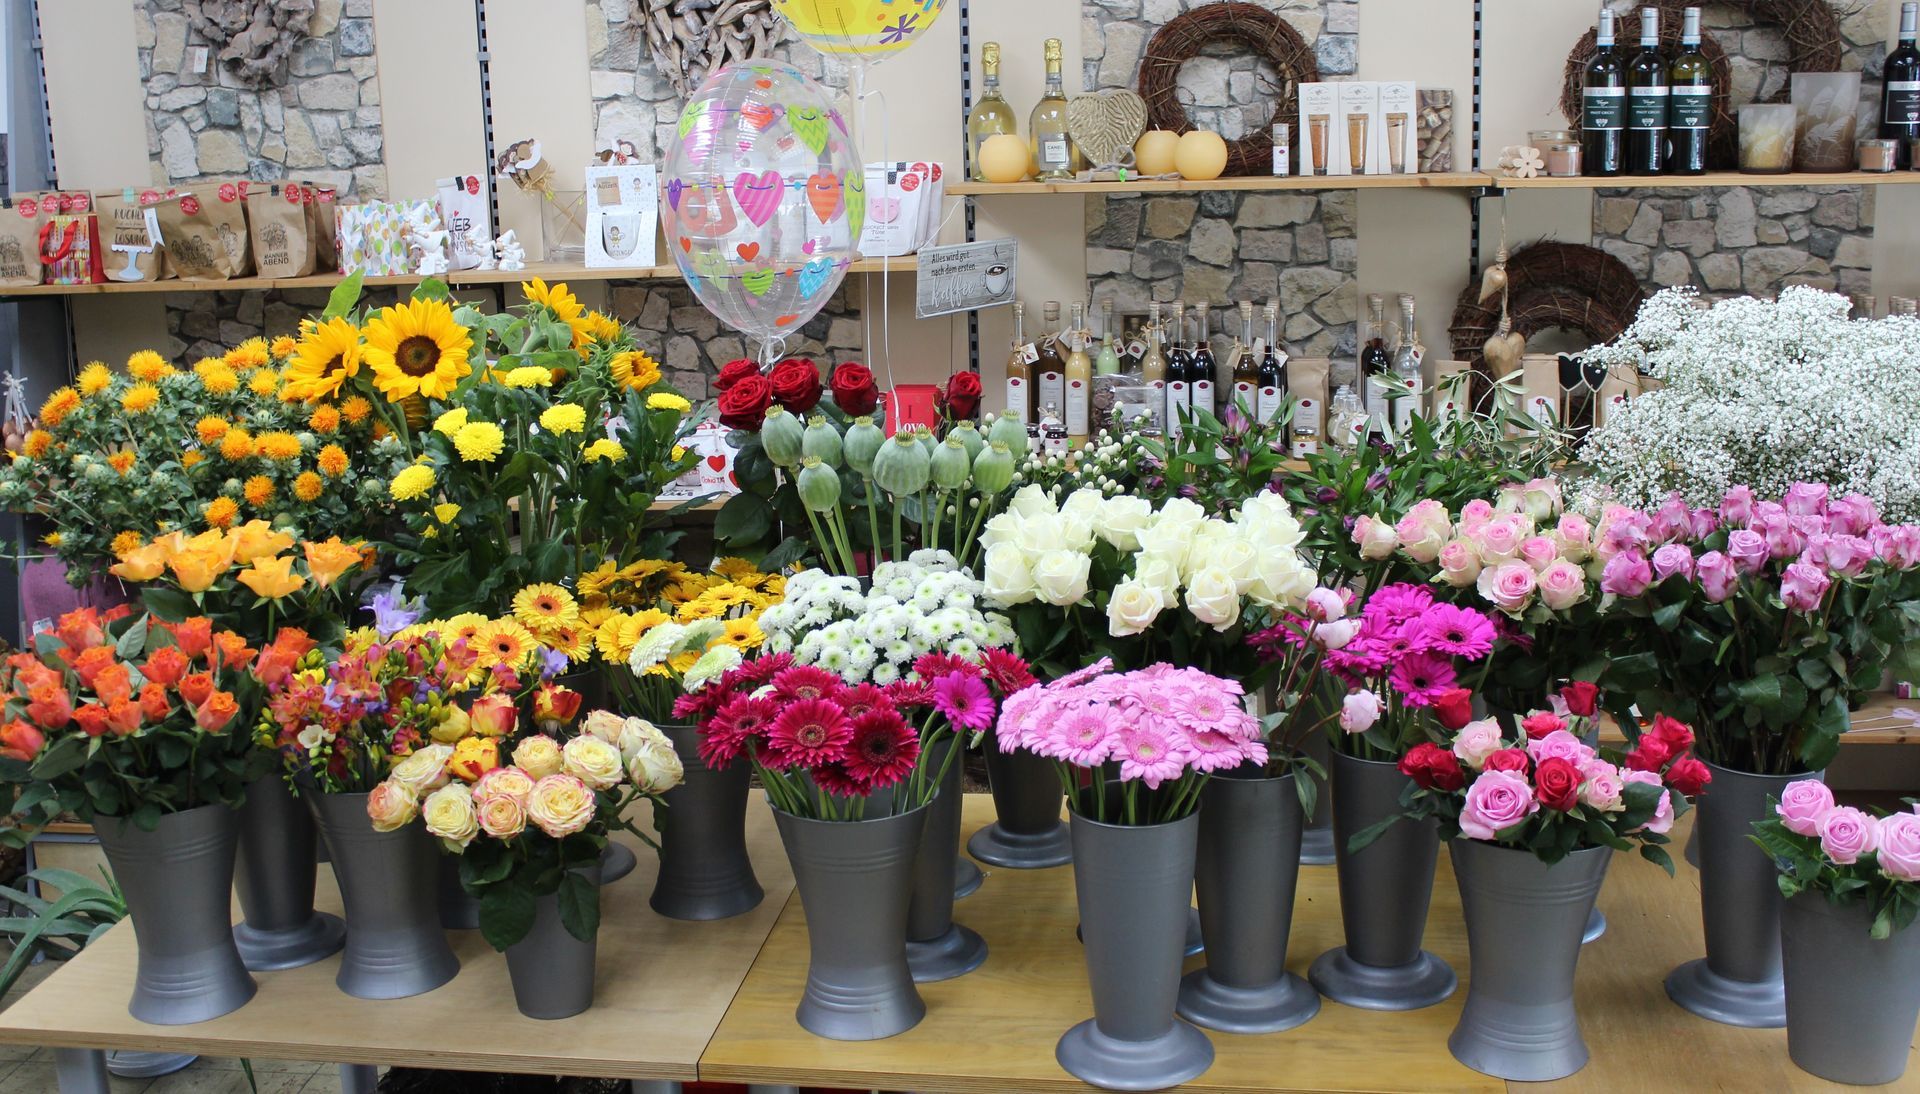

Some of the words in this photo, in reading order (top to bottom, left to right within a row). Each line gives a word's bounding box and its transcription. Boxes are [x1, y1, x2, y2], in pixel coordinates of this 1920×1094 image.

[263, 258, 289, 266] ABEND
[931, 252, 946, 264] Alles
[946, 250, 959, 262] wird
[959, 250, 970, 262] gut
[1, 270, 27, 278] ABEND
[930, 265, 944, 277] nach
[944, 264, 957, 275] dem
[957, 262, 976, 273] ersten
